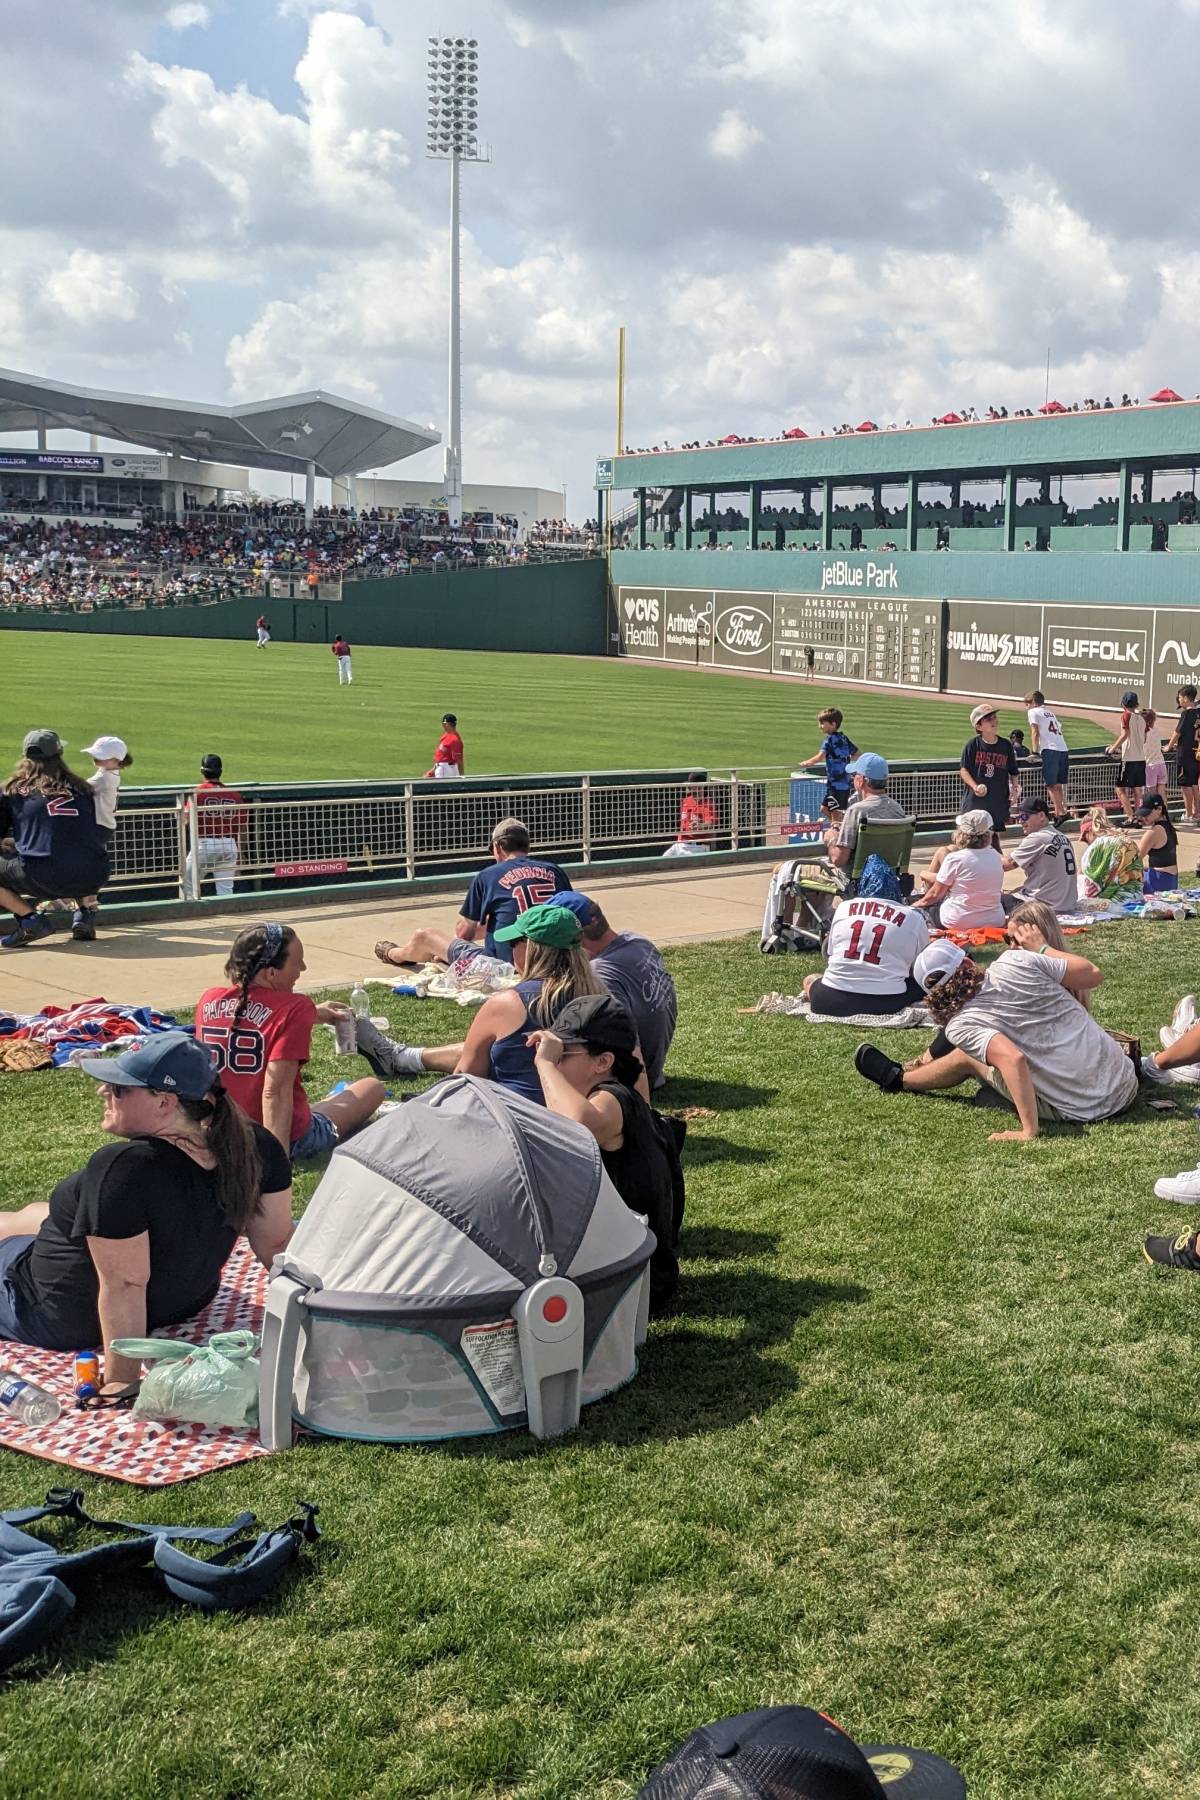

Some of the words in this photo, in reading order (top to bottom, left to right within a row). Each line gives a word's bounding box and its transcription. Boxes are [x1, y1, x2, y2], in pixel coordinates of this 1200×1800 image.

[38, 456, 73, 464] BABCOCK
[821, 561, 863, 590] jetBlue
[866, 562, 898, 588] Park
[635, 598, 660, 622] CVS
[805, 599, 857, 609] AMERICAN
[867, 601, 908, 612] LEAGUE
[625, 622, 659, 647] Health
[666, 612, 698, 633] Arthrex
[726, 611, 764, 648] Ford
[946, 631, 998, 653] SULLIVAN
[1014, 635, 1040, 656] TIRE
[1052, 638, 1140, 662] SUFFOLK
[960, 651, 975, 661] AND
[976, 652, 995, 663] AUTO
[1010, 655, 1039, 666] SERVICE
[1046, 671, 1088, 682] AMERICA'S
[1090, 675, 1145, 687] CONTRACTOR
[975, 751, 1009, 768] BOSTON
[46, 788, 79, 816] 2
[298, 863, 343, 873] STANDING
[1064, 848, 1076, 876] 8
[848, 901, 907, 928] RIVERA
[844, 919, 887, 966] 11
[203, 998, 273, 1028] PAPEBON
[201, 1025, 265, 1075] 58
